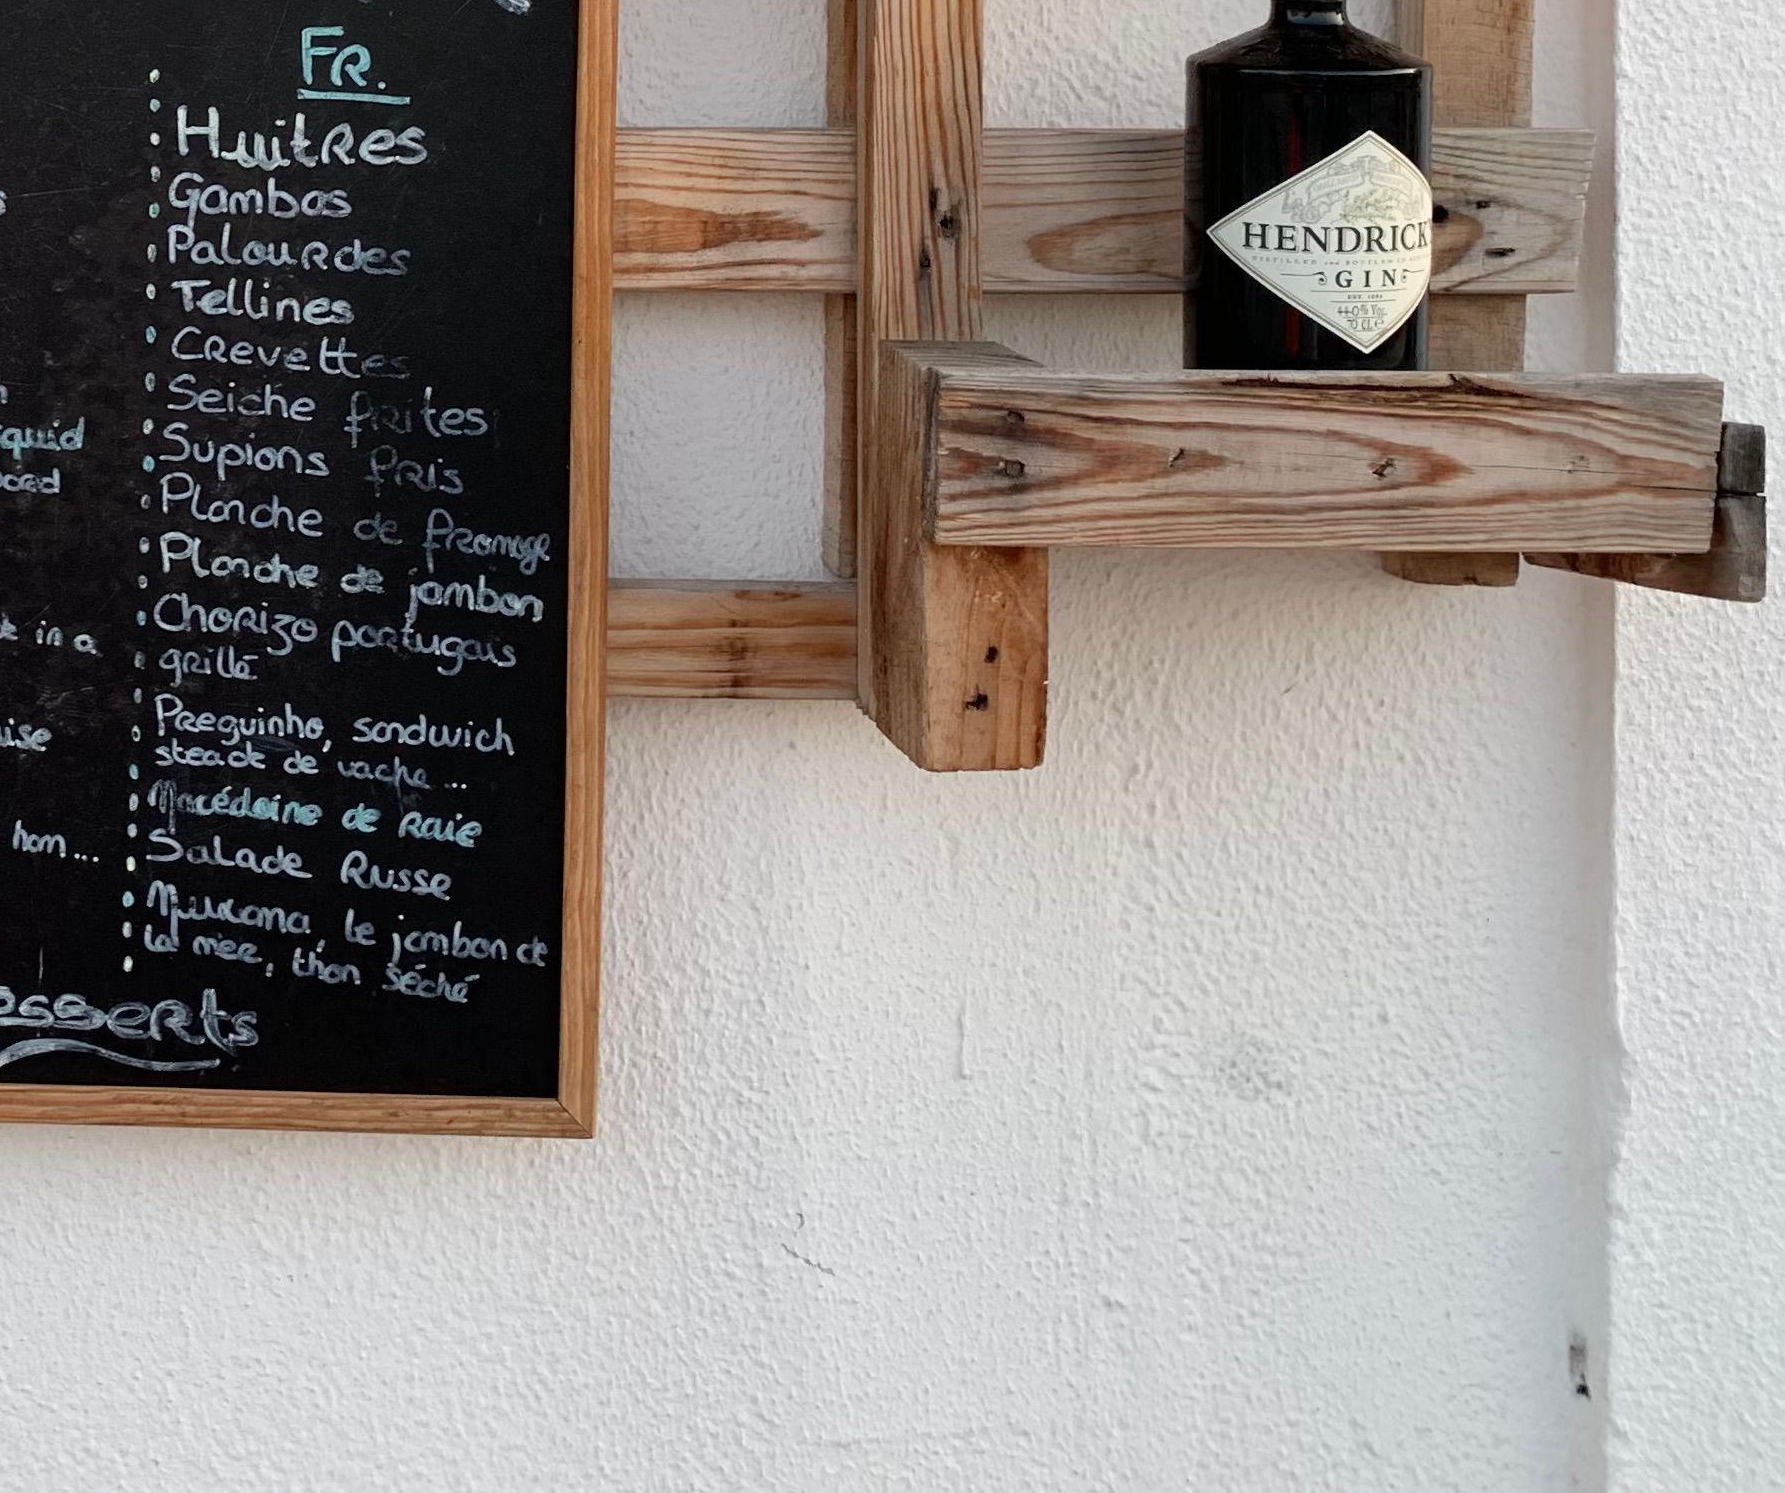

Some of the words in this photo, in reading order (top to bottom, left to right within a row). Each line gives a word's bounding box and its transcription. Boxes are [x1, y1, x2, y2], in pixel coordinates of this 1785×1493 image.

[168, 171, 353, 227] Gambas
[171, 277, 356, 326] Tellines
[1335, 269, 1398, 288] GIN
[167, 373, 316, 422] Seiche
[159, 422, 331, 482] Supions
[159, 471, 324, 538] Planche
[352, 512, 404, 547] de
[159, 531, 320, 589] Planche
[340, 564, 386, 595] de
[403, 568, 545, 623] jambon
[35, 619, 64, 647] in
[73, 633, 103, 658] a
[352, 713, 516, 757] sandwich
[283, 749, 320, 776] de
[341, 802, 384, 834] de
[145, 828, 314, 879] Salade
[340, 850, 453, 902] Russe
[388, 913, 509, 967] jambon
[516, 934, 550, 968] de
[292, 947, 362, 986] thon
